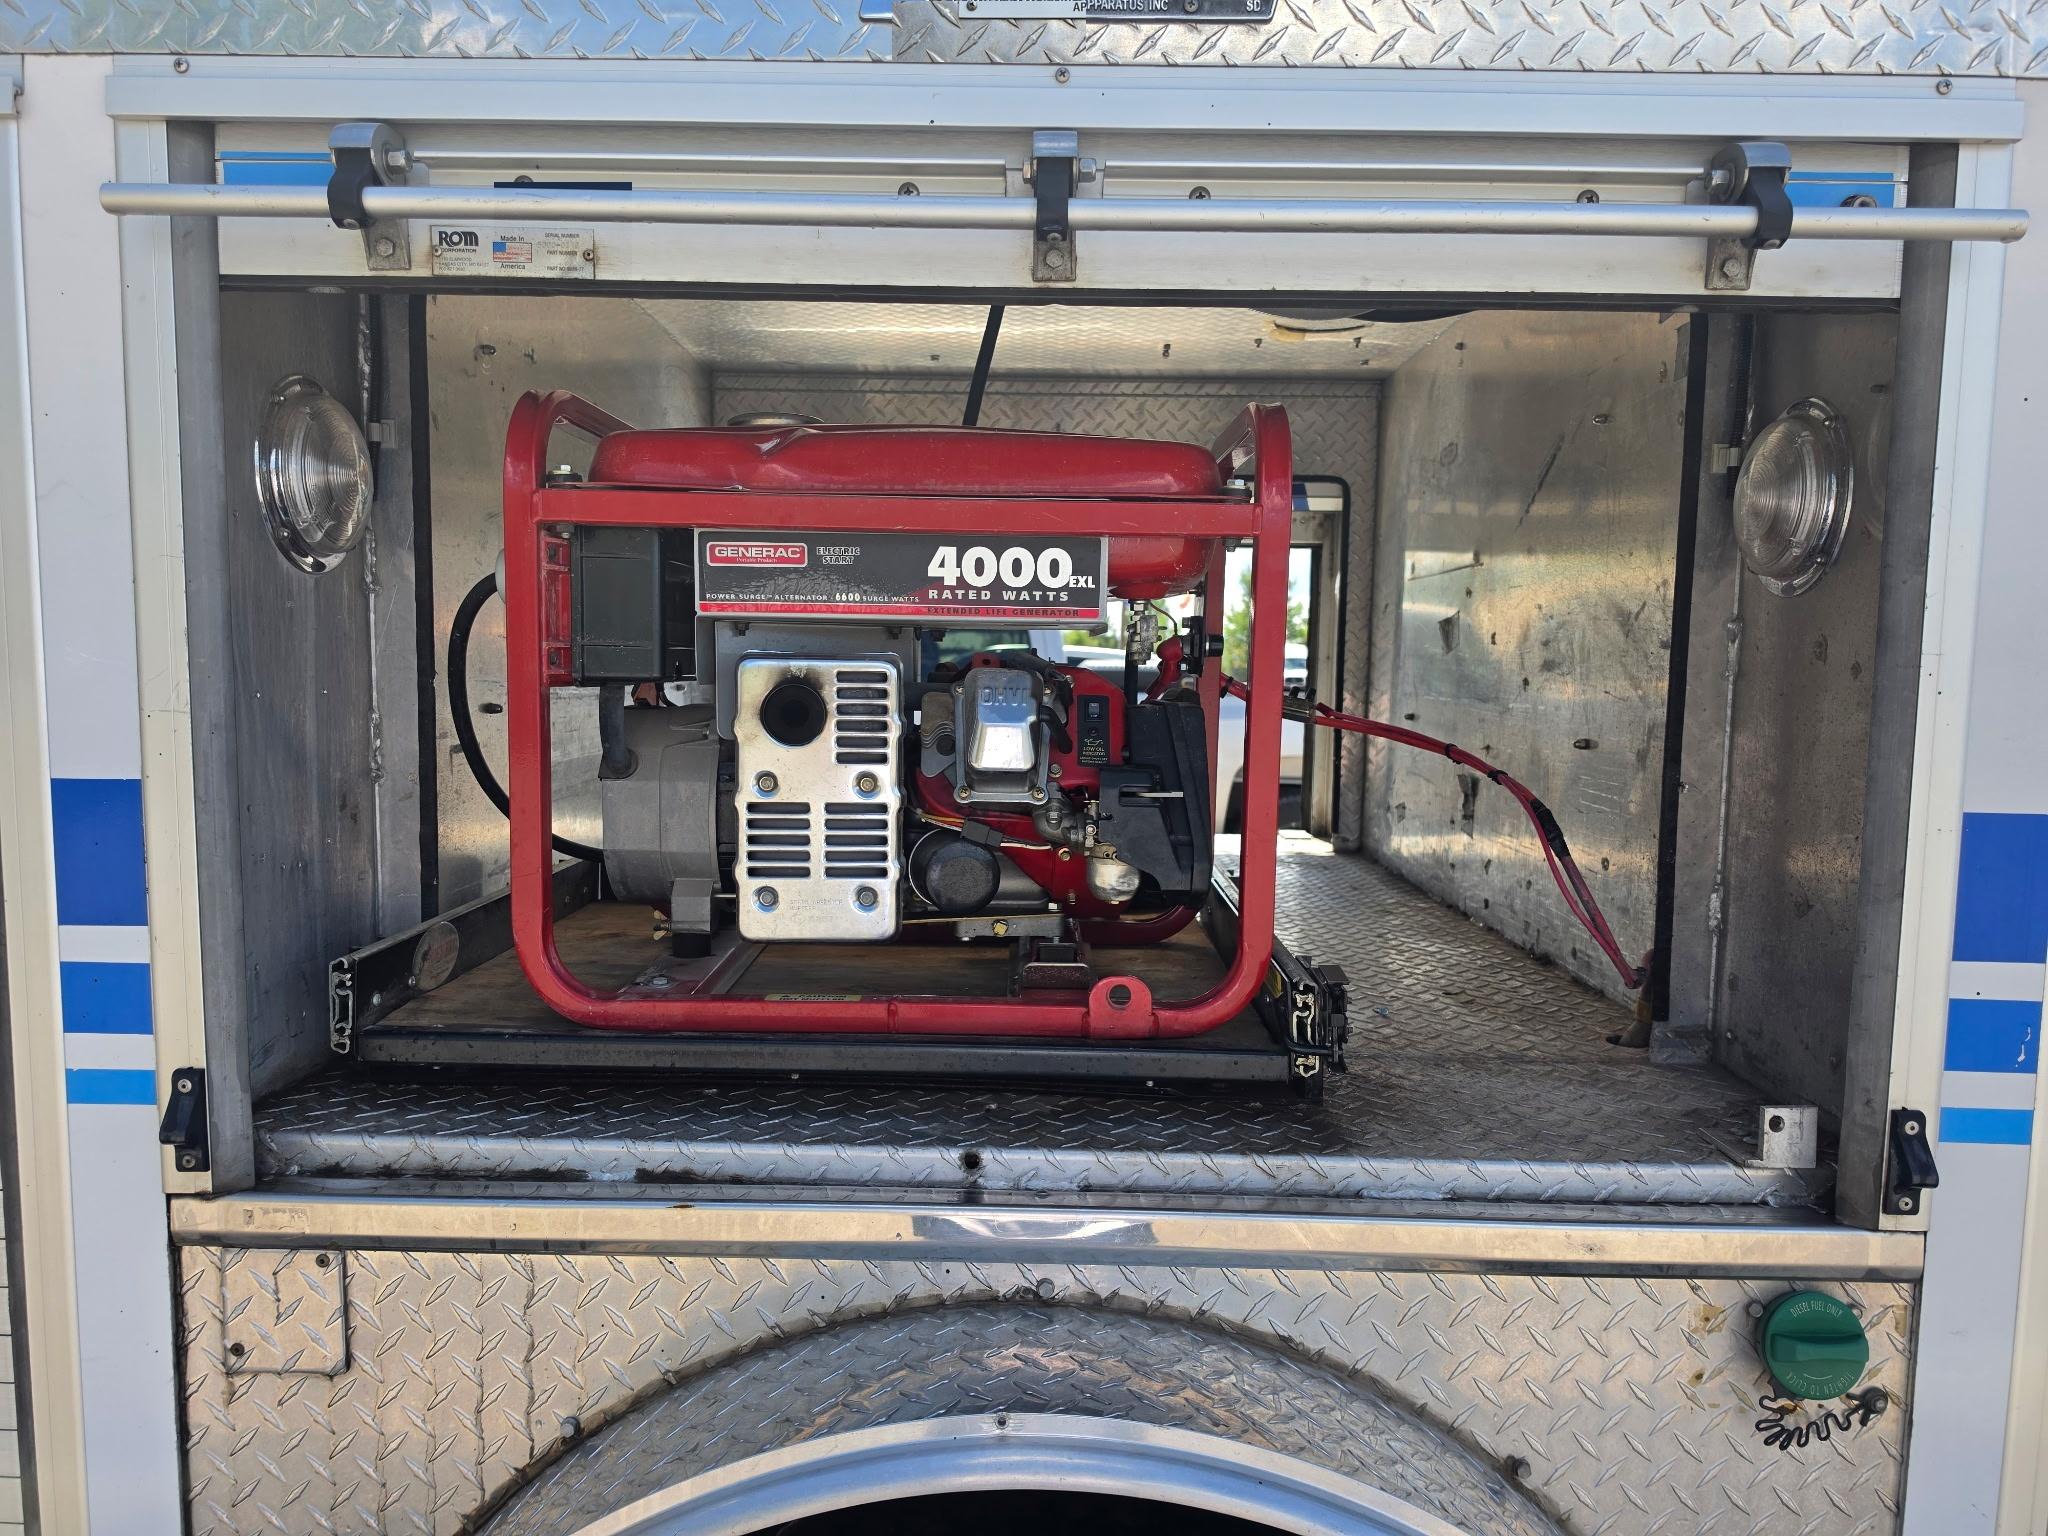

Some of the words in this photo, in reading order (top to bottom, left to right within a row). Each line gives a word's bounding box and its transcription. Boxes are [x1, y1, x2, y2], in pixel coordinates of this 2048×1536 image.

[1149, 0, 1168, 10] INC
[1246, 0, 1261, 11] SD
[438, 230, 479, 247] ROM
[714, 546, 801, 558] GENERAC
[816, 546, 860, 556] ELECTRIC
[823, 555, 855, 565] START
[927, 545, 1073, 589] 4000
[1069, 575, 1096, 589] EXL
[835, 592, 861, 602] 6600
[928, 589, 991, 600] RATED
[1003, 590, 1069, 602] WATTS
[927, 607, 981, 615] EXTENDED
[986, 608, 1008, 616] LIFE
[1012, 608, 1080, 617] GENERATOR
[1790, 1302, 1810, 1318] DIESEL
[1810, 1300, 1825, 1312] FUEL
[1827, 1302, 1844, 1318] ONLY
